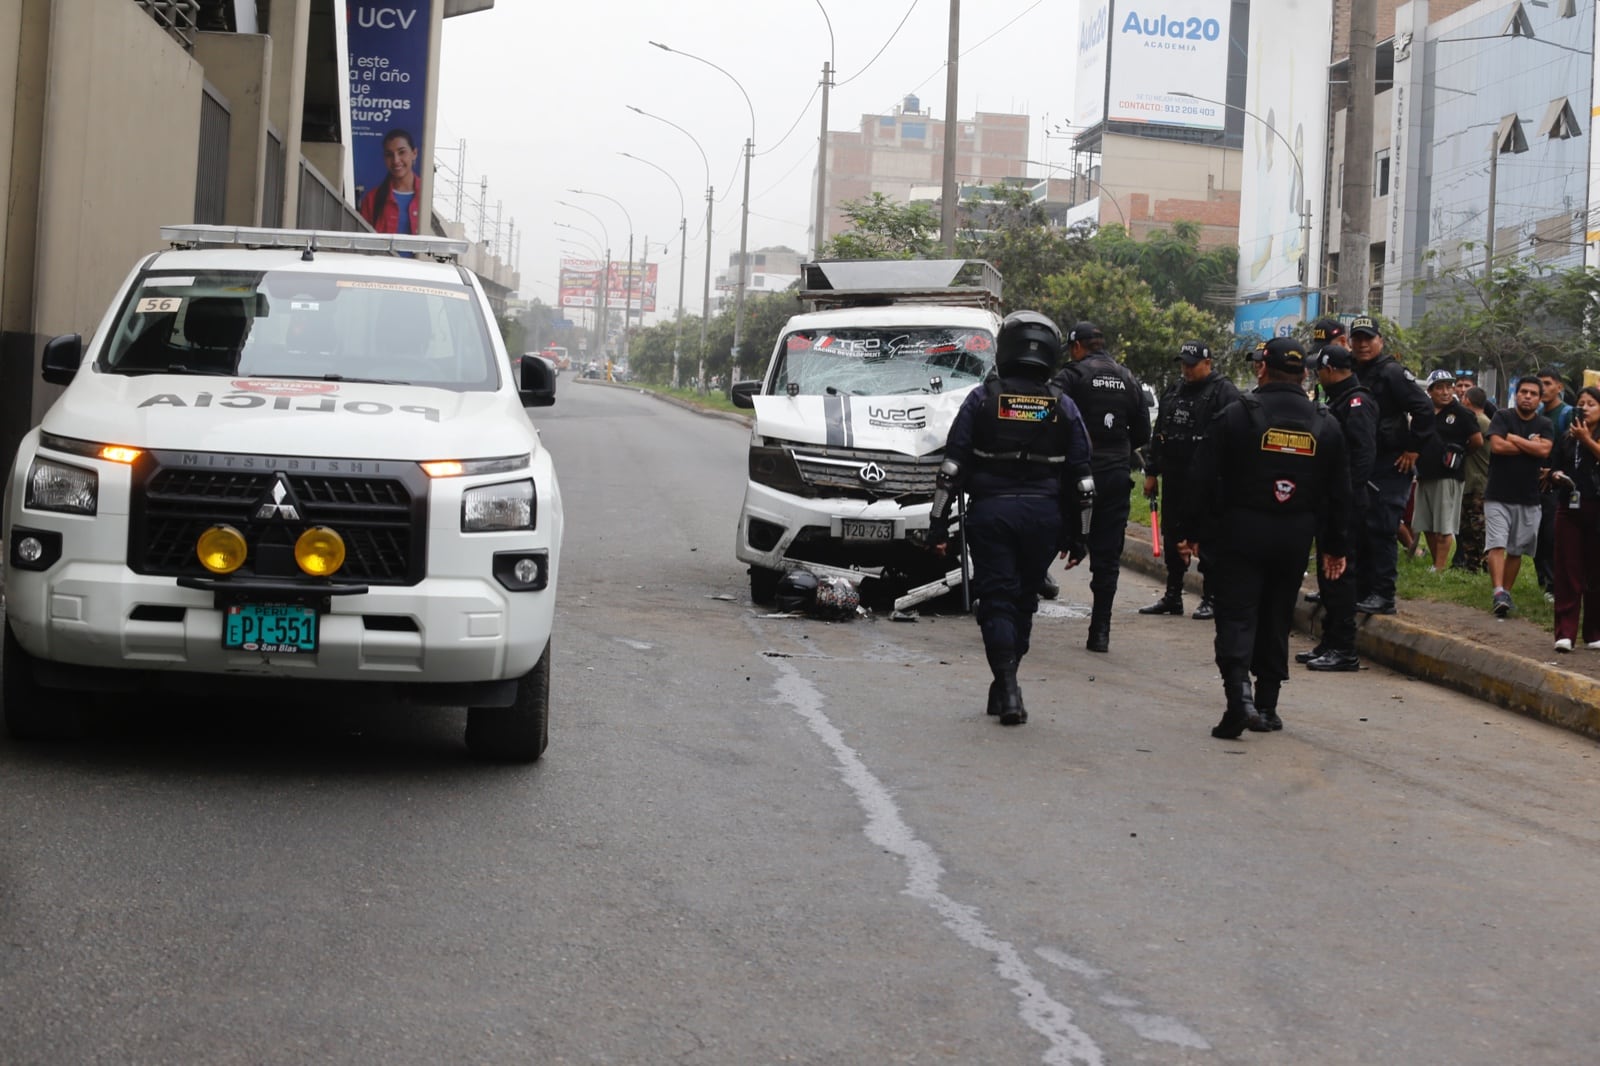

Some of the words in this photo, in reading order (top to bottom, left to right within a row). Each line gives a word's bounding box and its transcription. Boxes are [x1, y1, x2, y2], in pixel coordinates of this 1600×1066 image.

[358, 7, 416, 29] UCV
[1122, 11, 1220, 41] Aula20
[1144, 41, 1196, 51] ACADEMIA
[357, 56, 389, 68] este
[363, 67, 376, 81] el
[380, 69, 410, 82] año
[1119, 100, 1163, 112] CONTACTO:
[1164, 105, 1181, 114] 912
[1200, 106, 1215, 116] 403
[145, 299, 171, 311] 56
[836, 338, 880, 352] TRD
[869, 405, 926, 421] WRC
[182, 455, 381, 473] MITSUBISHI
[255, 607, 288, 616] PERU
[261, 643, 277, 651] San
[279, 644, 297, 653] Blas
